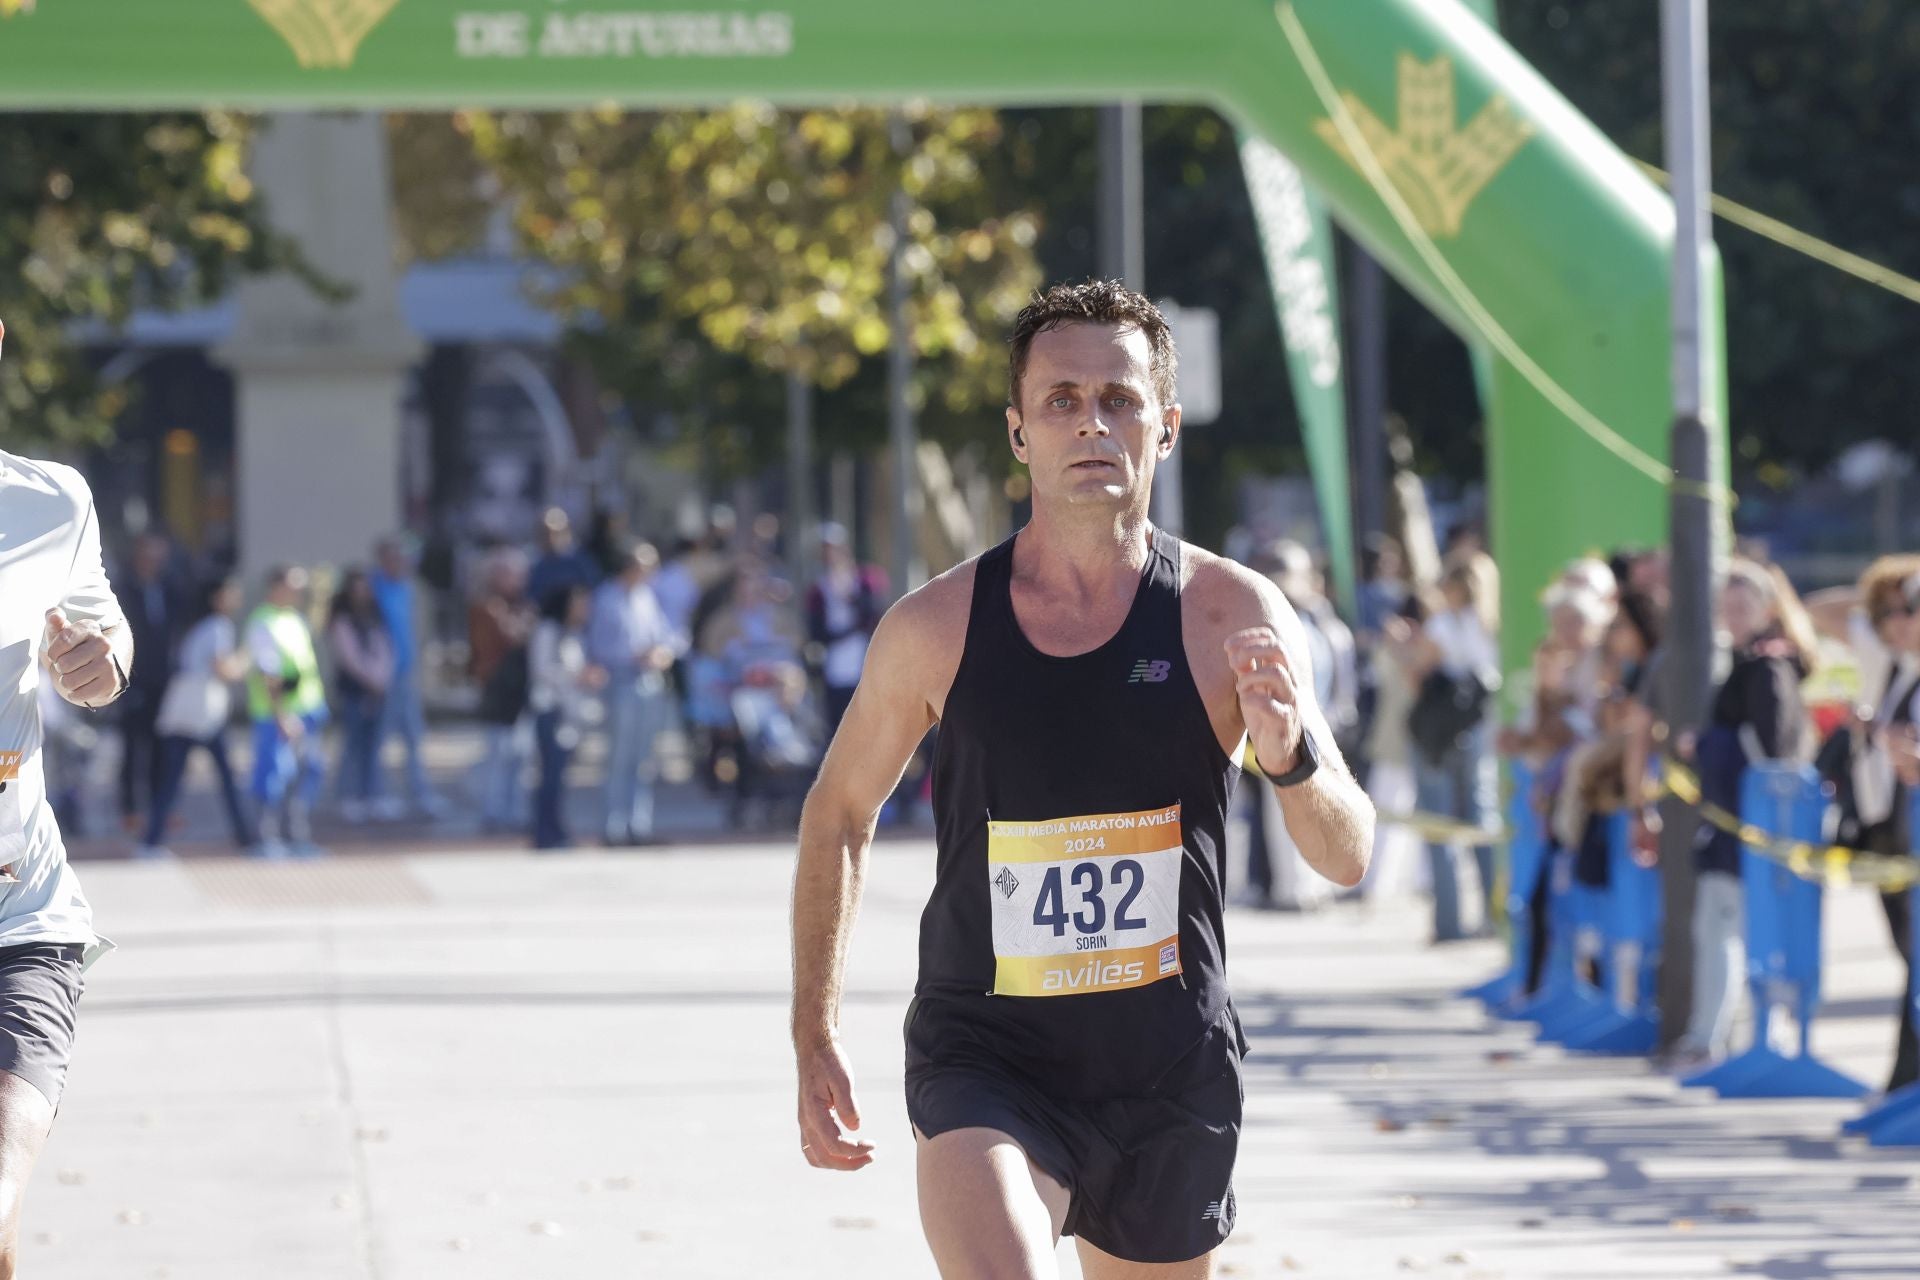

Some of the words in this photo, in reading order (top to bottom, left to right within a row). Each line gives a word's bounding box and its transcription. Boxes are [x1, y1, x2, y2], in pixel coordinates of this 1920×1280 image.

[457, 12, 527, 56] DE
[541, 11, 792, 56] ASTURIAS
[1028, 822, 1067, 837] MEDIA
[1070, 815, 1135, 833] MARATÓN
[1138, 809, 1177, 827] AVILÉS
[1064, 836, 1106, 853] 2024
[1033, 859, 1147, 937] 432
[1076, 935, 1107, 950] SORIN
[1042, 958, 1145, 991] avilés
